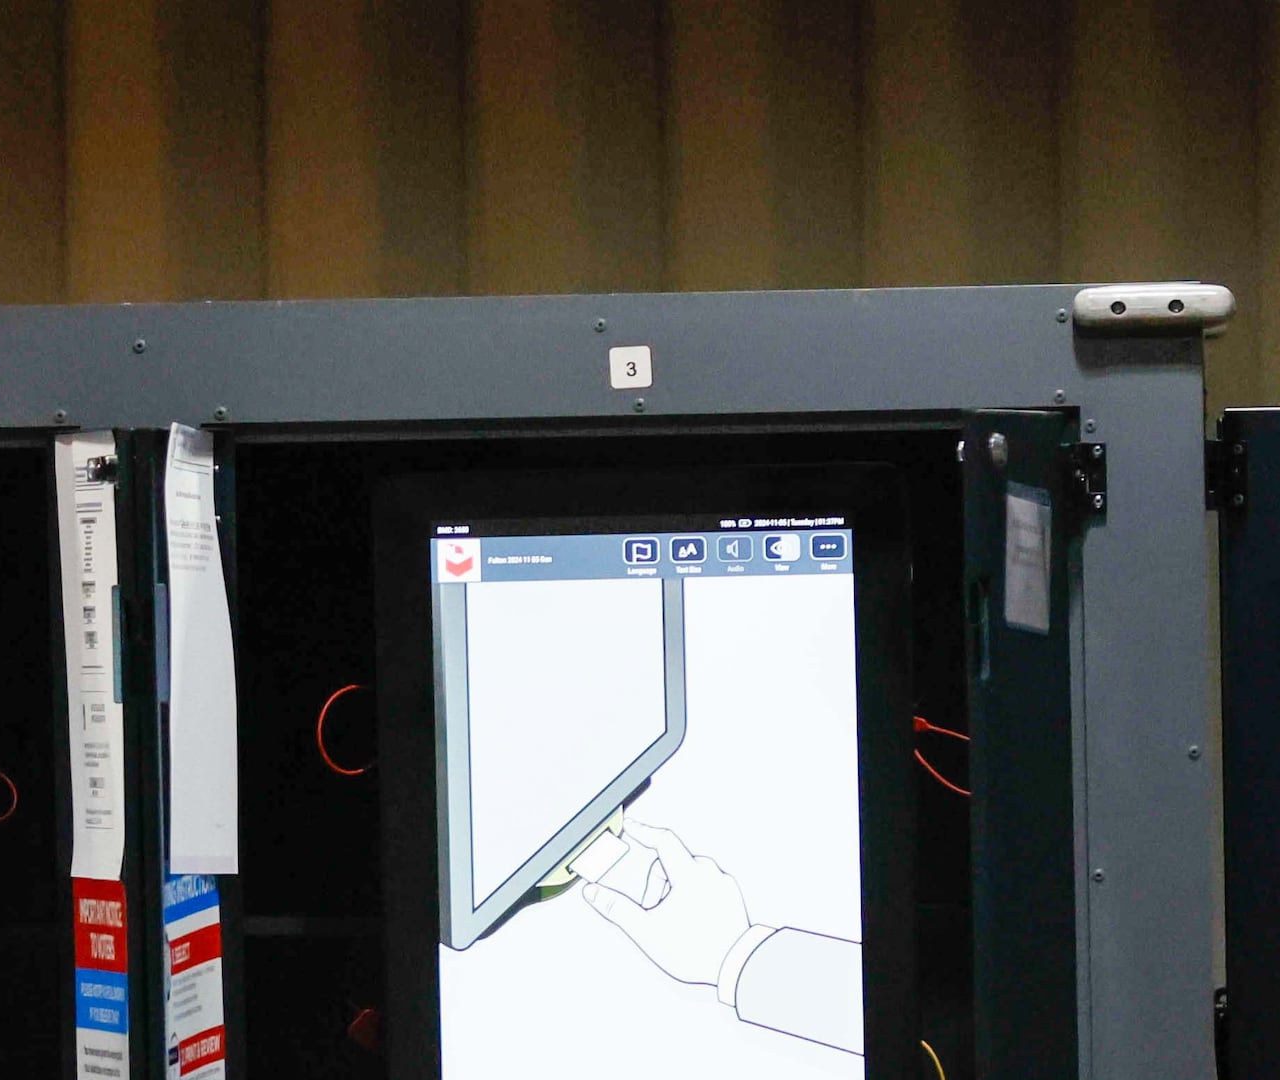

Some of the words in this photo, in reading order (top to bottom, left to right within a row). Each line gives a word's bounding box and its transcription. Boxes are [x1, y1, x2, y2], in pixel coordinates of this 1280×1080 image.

[626, 361, 637, 377] 3
[627, 567, 657, 576] Language
[727, 565, 744, 573] Audio
[775, 564, 790, 572] View
[821, 563, 837, 571] More
